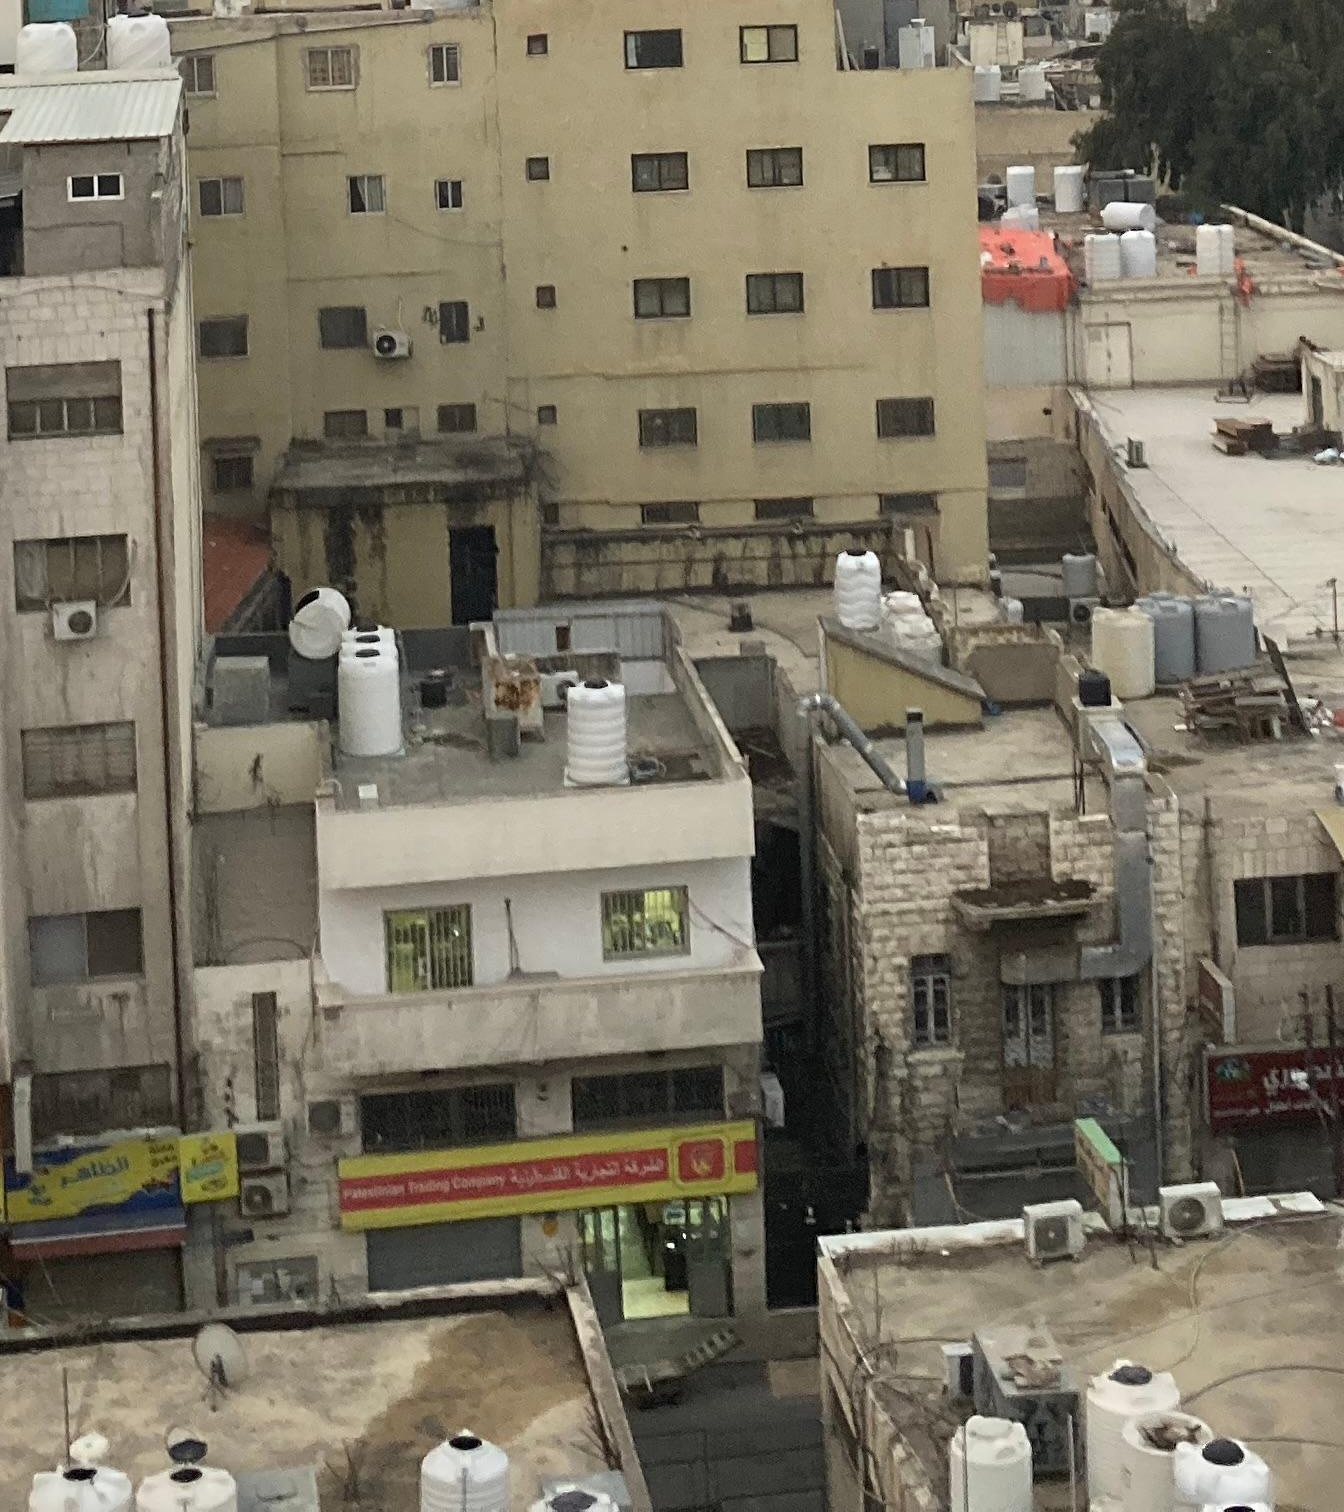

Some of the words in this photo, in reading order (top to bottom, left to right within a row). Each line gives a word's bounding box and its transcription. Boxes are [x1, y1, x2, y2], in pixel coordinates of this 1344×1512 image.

[344, 1184, 406, 1199] Palestinian
[408, 1179, 450, 1193] Trading
[451, 1174, 506, 1192] Company
